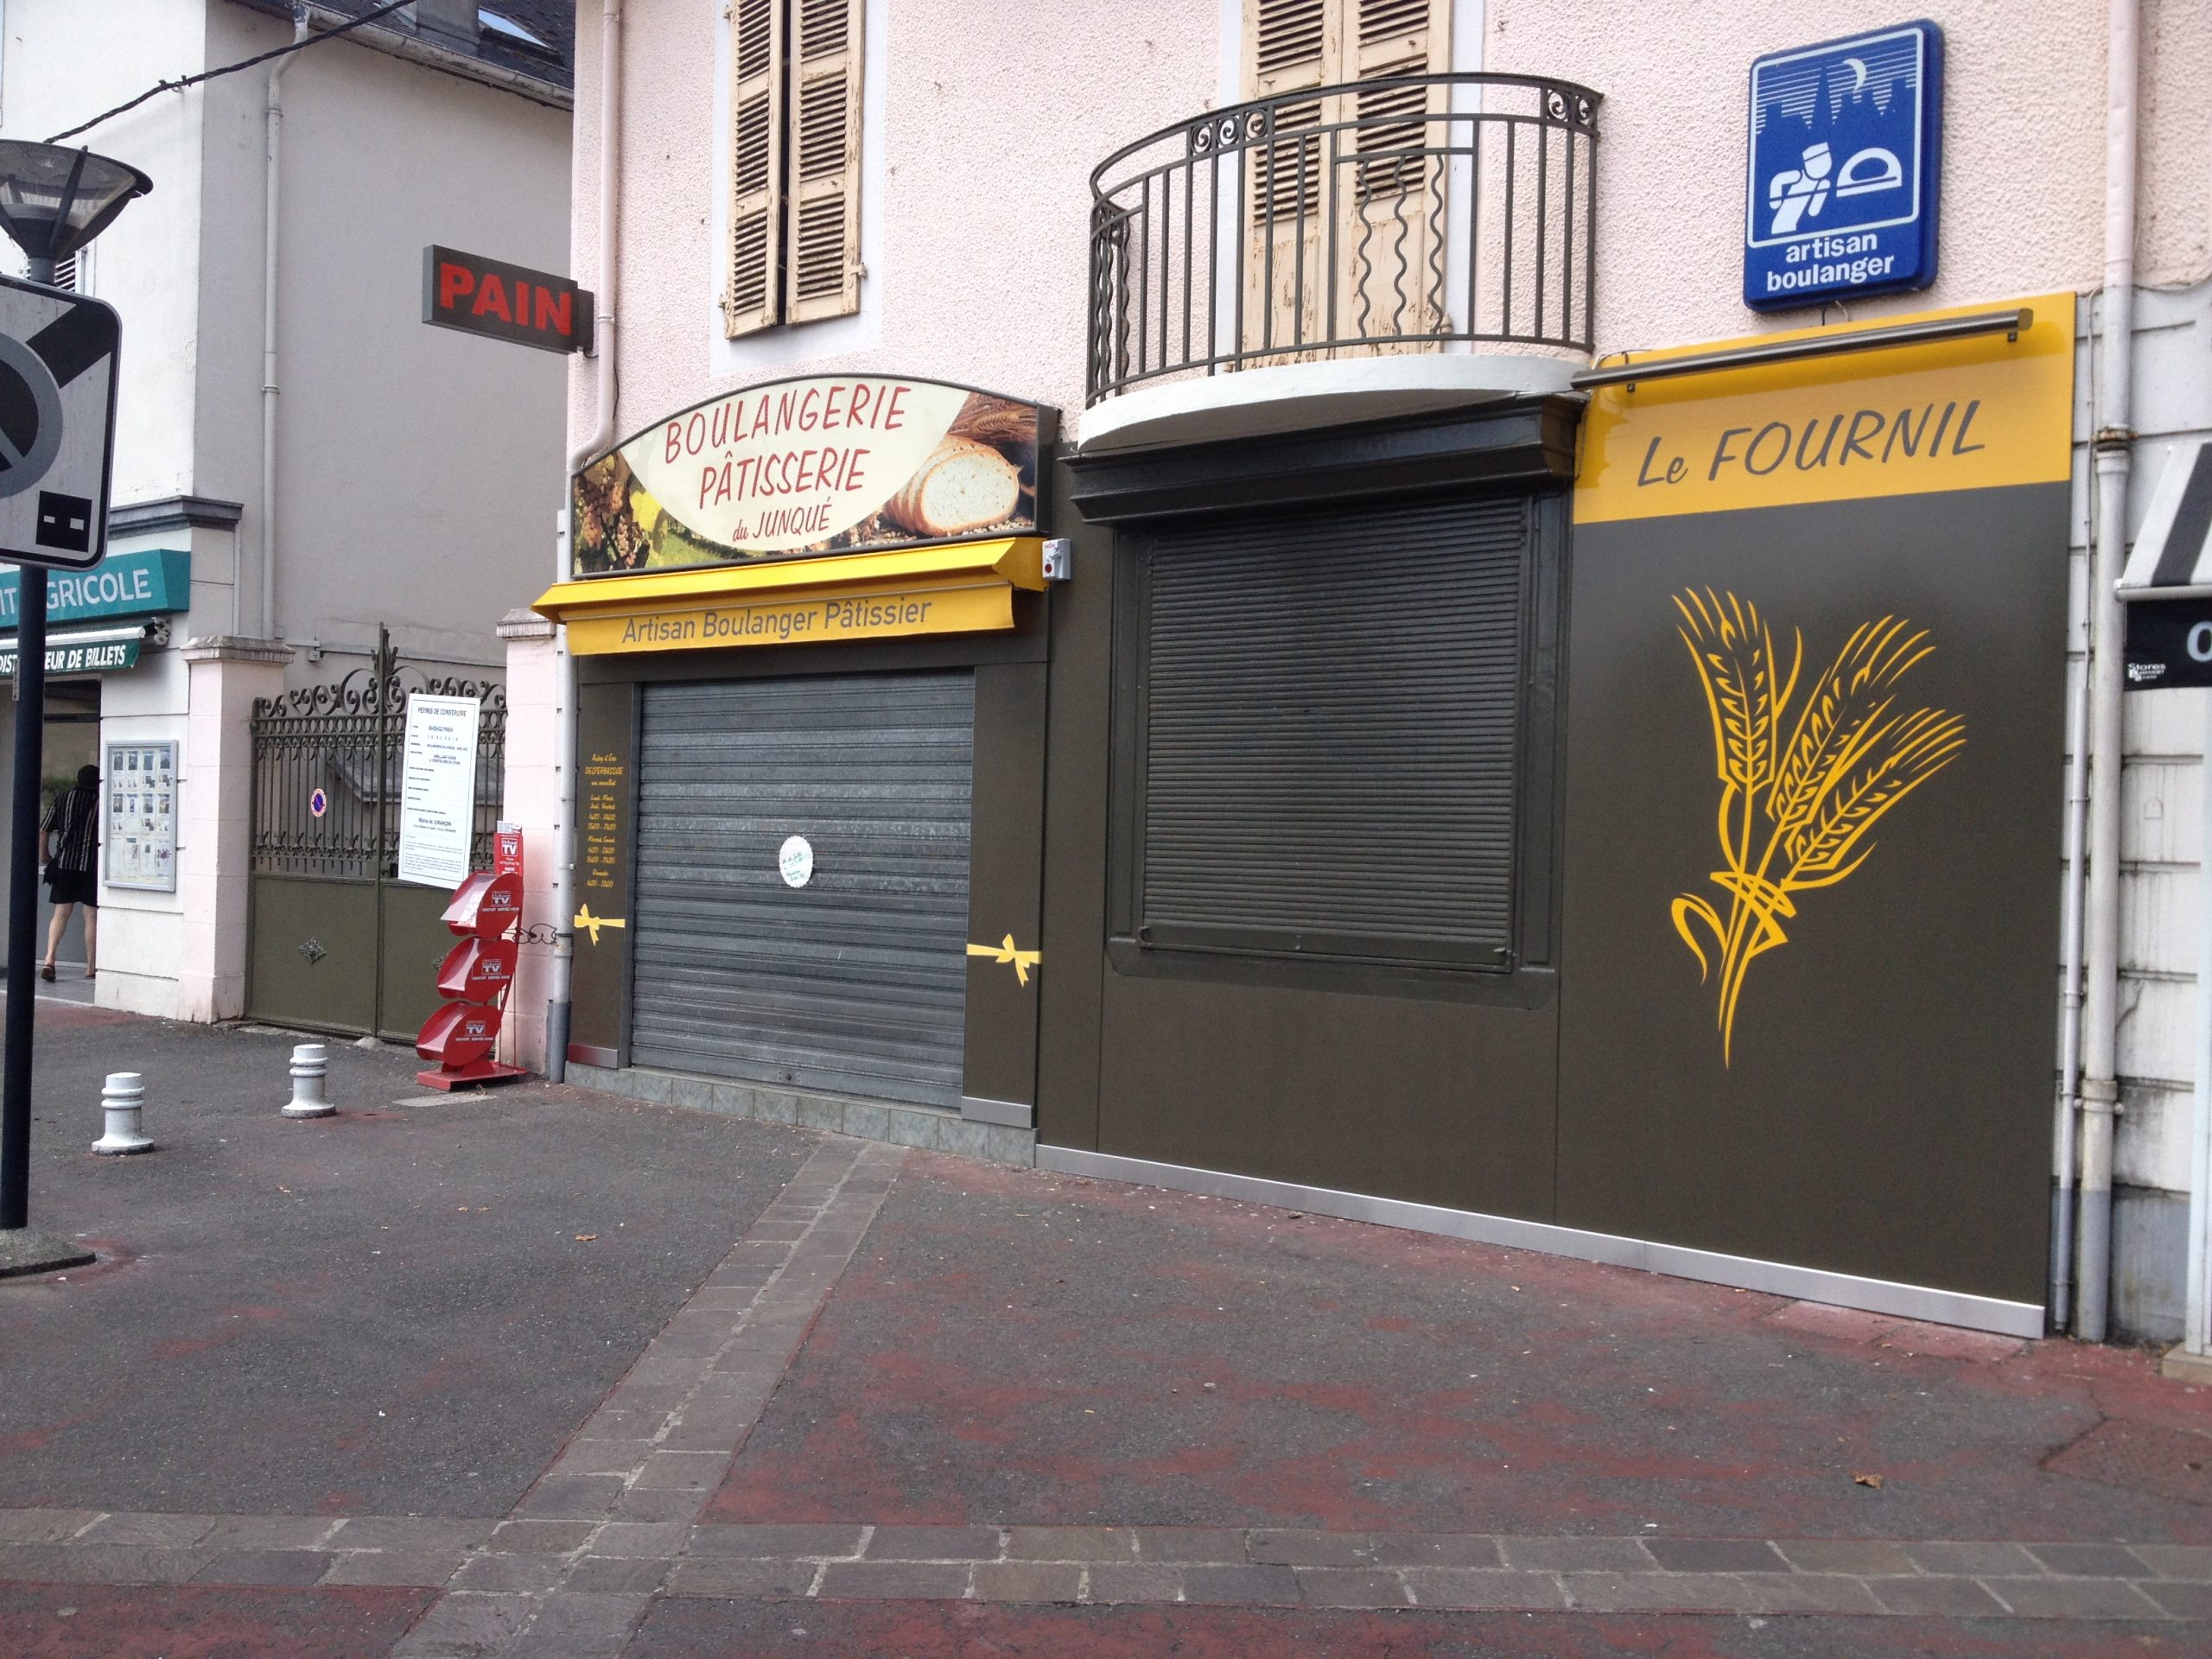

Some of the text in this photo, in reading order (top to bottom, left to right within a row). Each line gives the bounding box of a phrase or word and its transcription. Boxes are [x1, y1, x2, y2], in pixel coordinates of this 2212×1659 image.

[1785, 233, 1878, 263] artisan
[1767, 255, 1894, 291] boulanger
[440, 262, 572, 336] PAIN
[664, 383, 912, 464] BOULANGERIE
[1637, 400, 1986, 486] Le FOURNIL
[699, 447, 870, 510] PÂTISSERIE
[733, 496, 832, 542] du JUNQUÉ
[47, 569, 152, 609] GRICOLE
[622, 596, 932, 643] Artisan Boulanger Pâtissier
[67, 649, 83, 668] DE
[86, 645, 126, 667] BILLETS
[502, 844, 518, 855] TV
